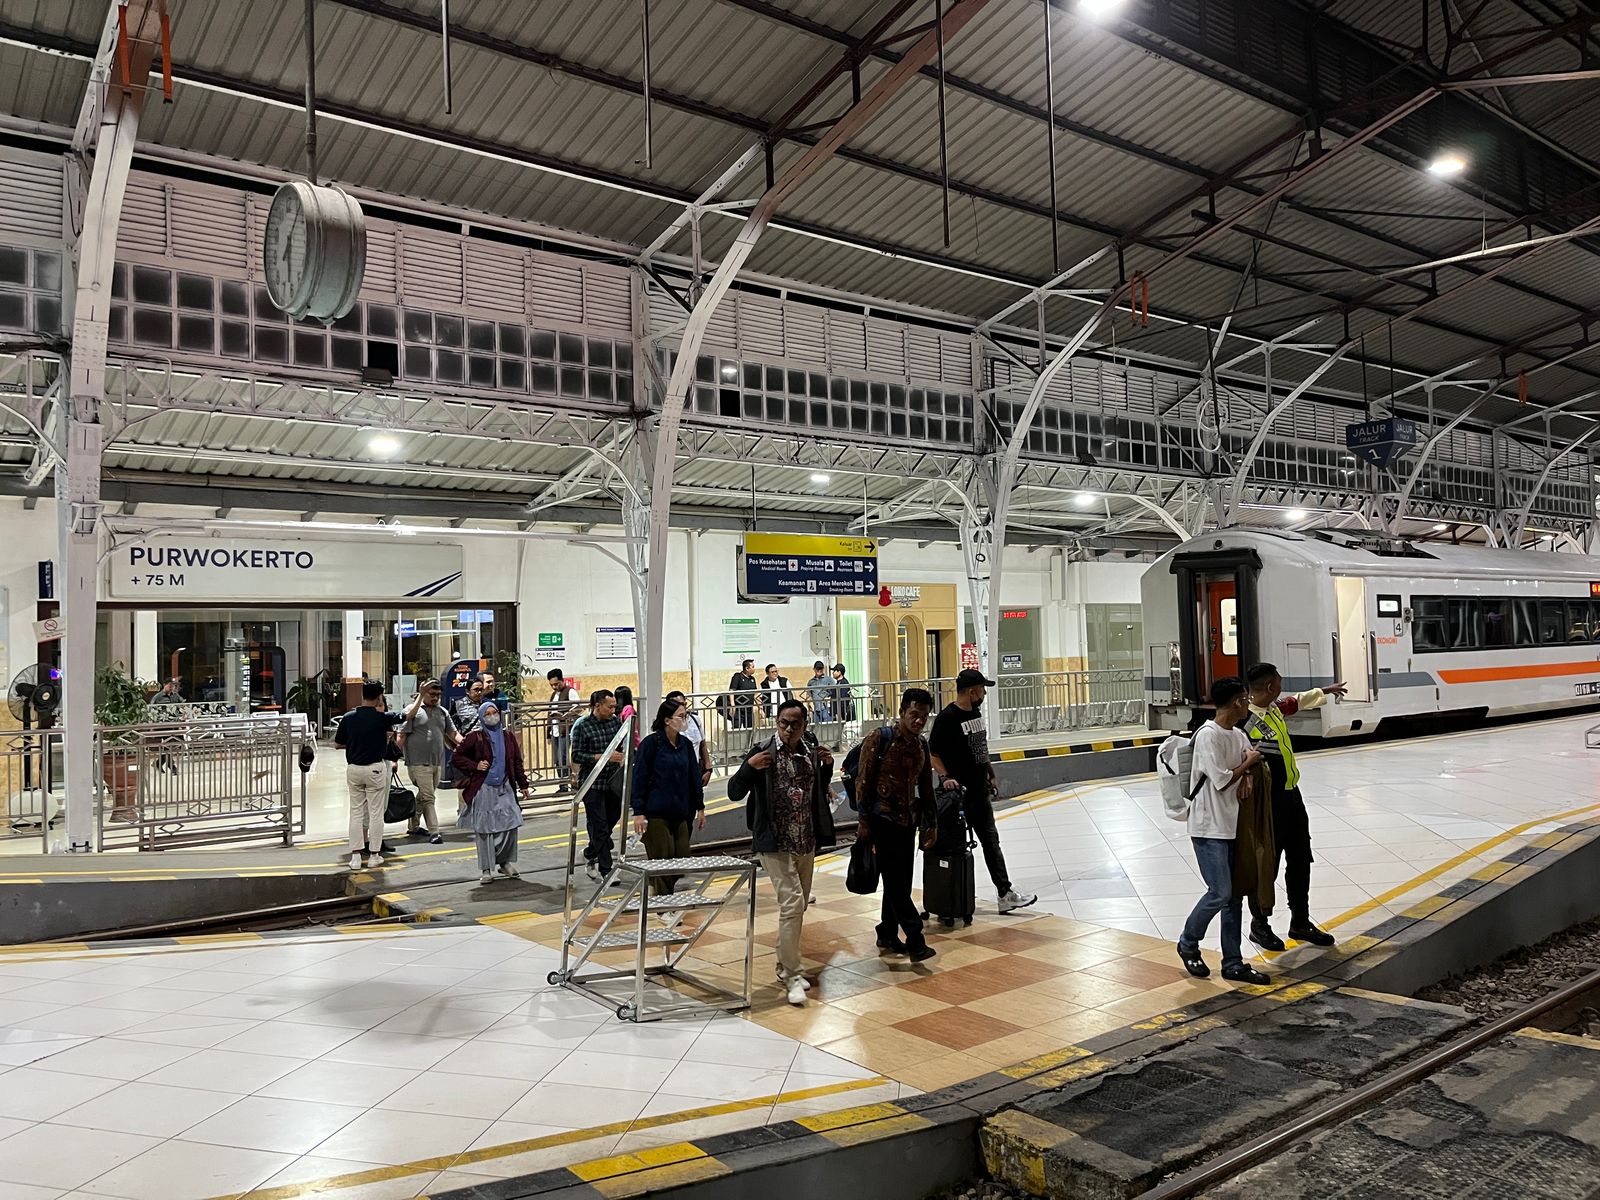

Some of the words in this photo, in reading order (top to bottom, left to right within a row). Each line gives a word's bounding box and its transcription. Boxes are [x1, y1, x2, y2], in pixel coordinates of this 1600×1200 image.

[1352, 424, 1386, 438] JALUR
[1395, 424, 1413, 434] JALUR
[1360, 435, 1380, 443] TRACK
[1368, 449, 1382, 460] 1
[1391, 447, 1403, 459] 1
[130, 547, 314, 569] PURWOKERTO
[145, 574, 164, 586] 75
[169, 574, 185, 586] M
[891, 586, 905, 596] LOKO
[905, 586, 921, 597] CAFE
[1395, 623, 1402, 632] 4
